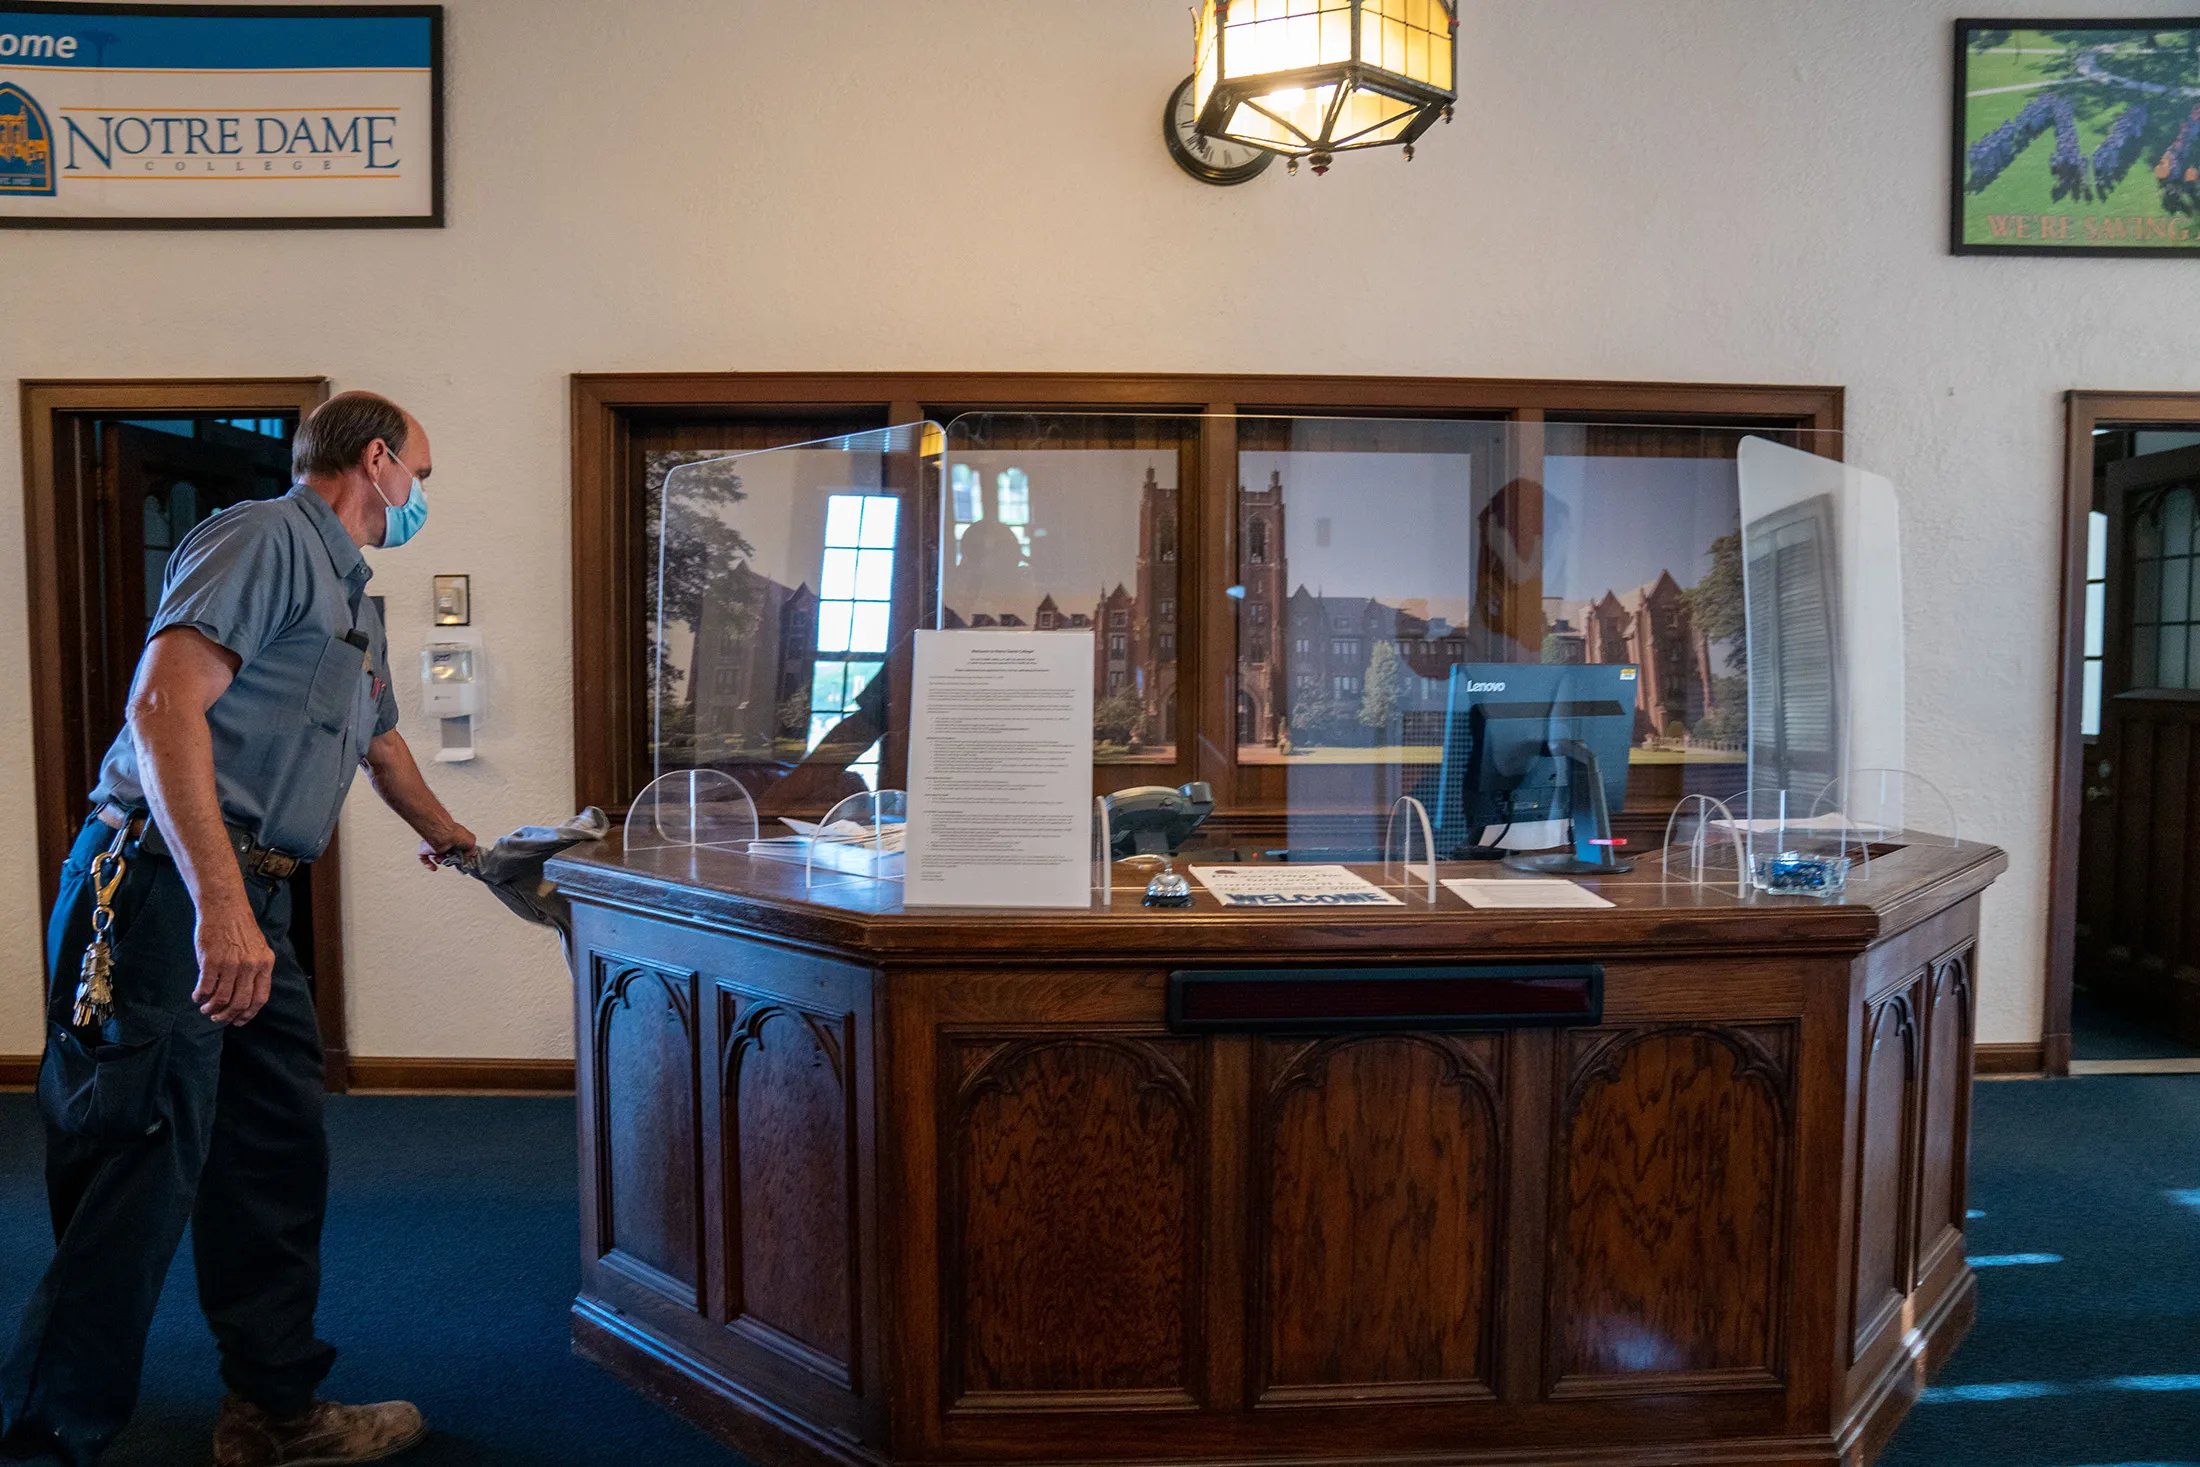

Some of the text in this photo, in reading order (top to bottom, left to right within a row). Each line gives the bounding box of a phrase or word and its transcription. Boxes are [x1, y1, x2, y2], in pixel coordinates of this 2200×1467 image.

[59, 116, 401, 170] NOTRE DAME
[145, 160, 332, 172] COLLEGE
[1987, 215, 2190, 241] WE'RE SAVING
[1467, 680, 1506, 692] Lenovo
[1225, 893, 1389, 905] WELCOME
